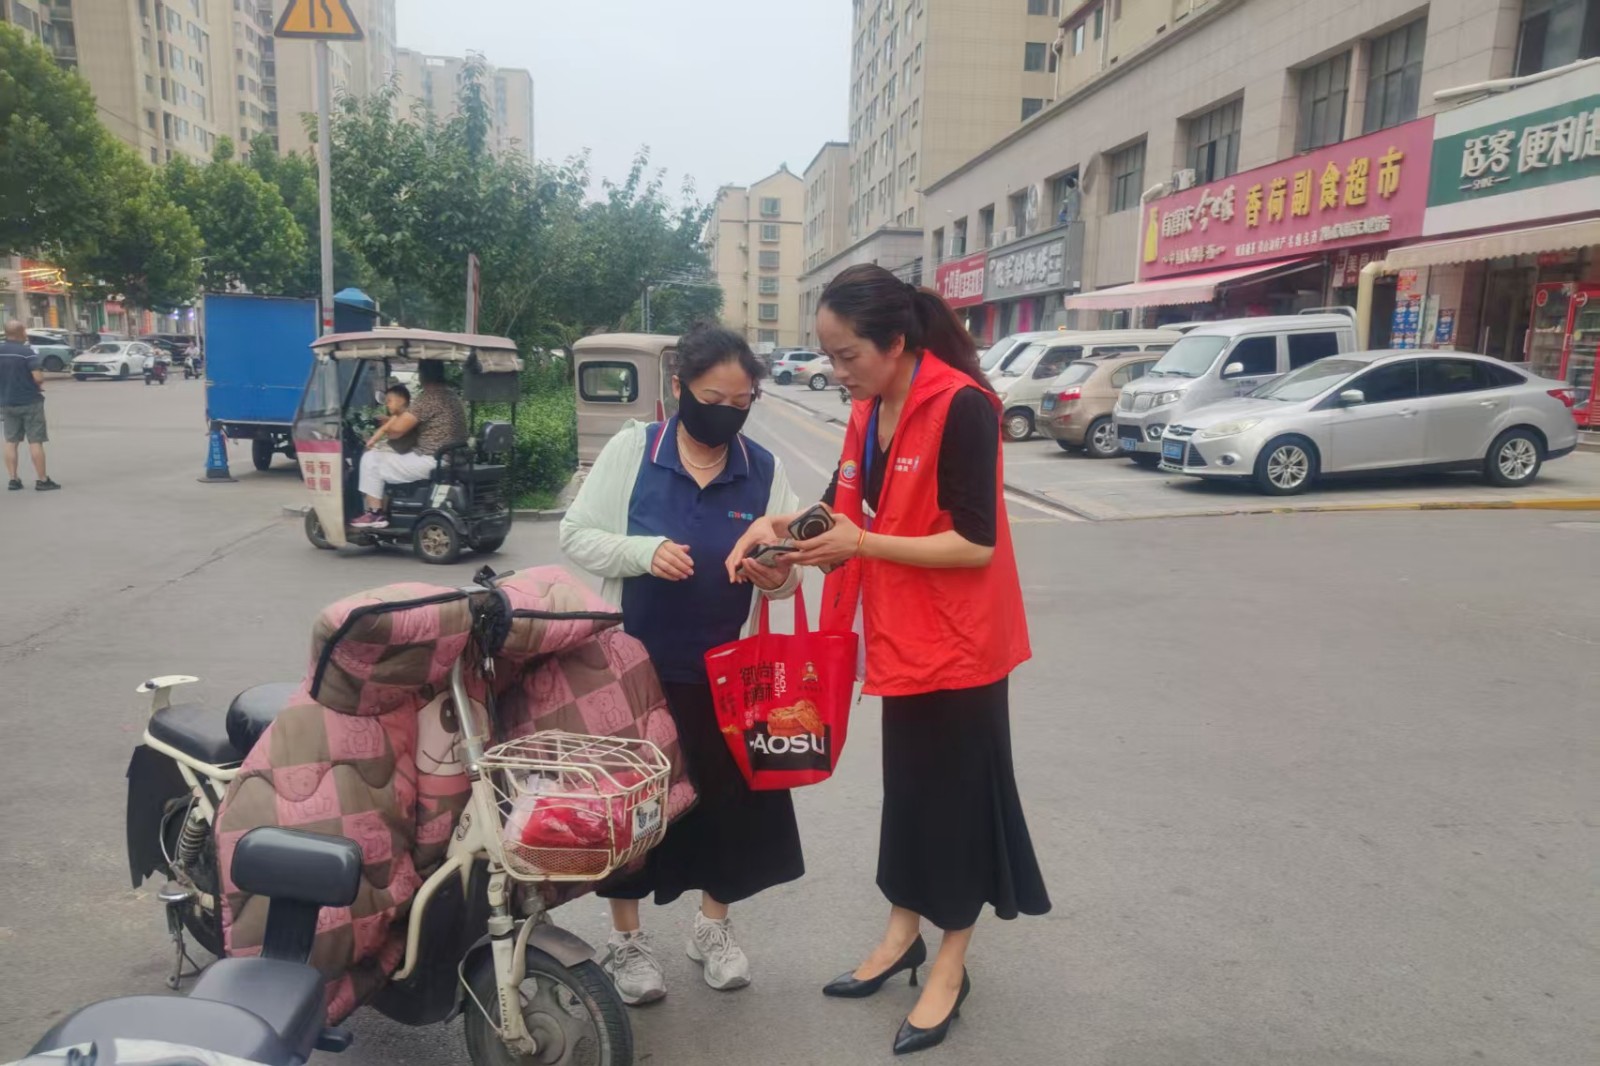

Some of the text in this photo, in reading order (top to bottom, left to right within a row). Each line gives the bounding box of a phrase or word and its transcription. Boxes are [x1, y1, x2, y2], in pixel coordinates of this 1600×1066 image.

[1245, 145, 1404, 229] 香荷副食超市
[749, 733, 826, 755] AOSU
